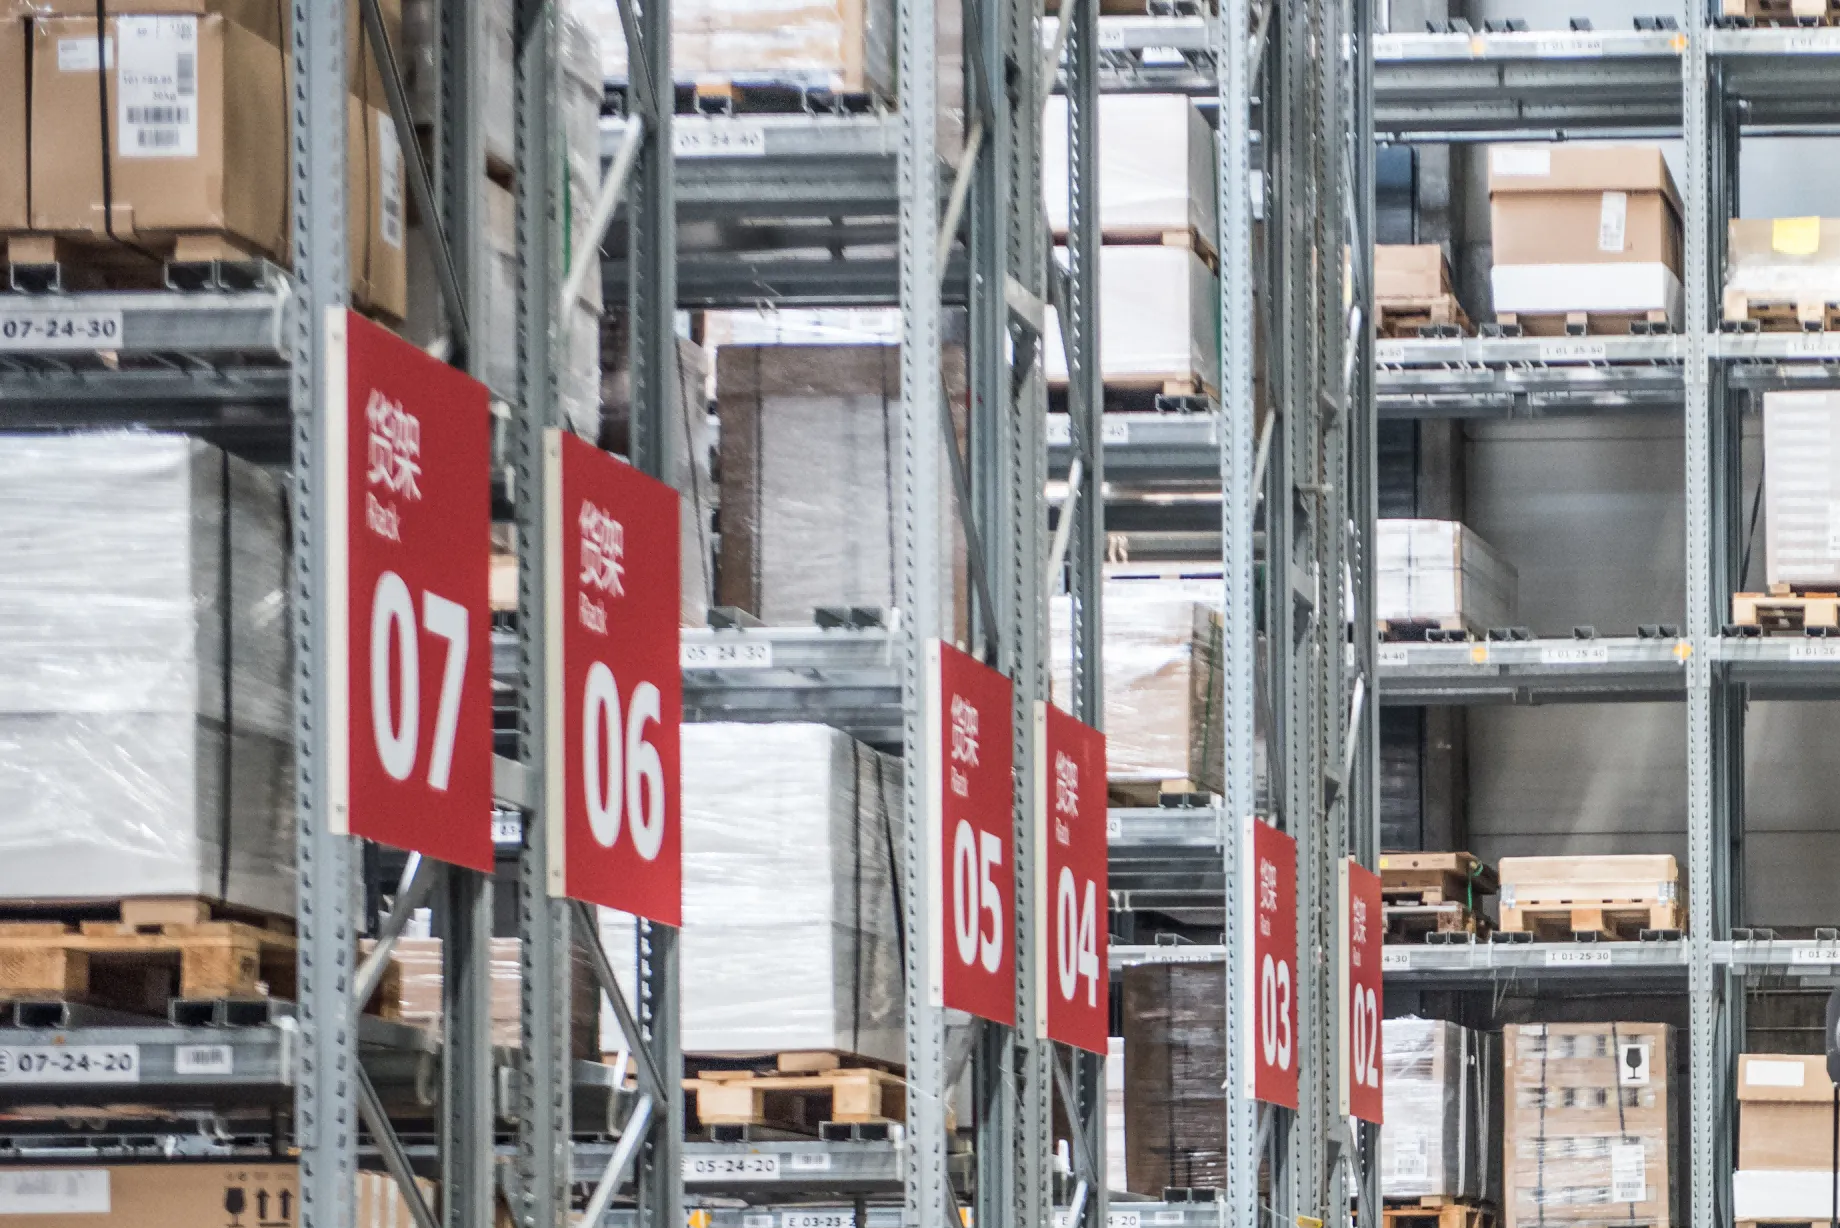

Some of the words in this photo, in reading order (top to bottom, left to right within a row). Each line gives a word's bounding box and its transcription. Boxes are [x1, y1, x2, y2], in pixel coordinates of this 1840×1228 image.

[3, 319, 117, 338] 07-24-30
[366, 387, 421, 500] 货架
[366, 492, 402, 542] Rack
[579, 498, 625, 597] 货架
[579, 591, 608, 636] Rack
[370, 569, 469, 791] 07
[583, 660, 665, 861] 06
[951, 692, 979, 767] 货架
[951, 765, 970, 798] Rack
[1055, 749, 1079, 817] 货架
[954, 818, 1004, 974] 05
[1260, 855, 1277, 912] 货架
[1057, 865, 1100, 1008] 04
[1353, 894, 1366, 944] 货架
[1562, 952, 1609, 961] 01-25-30
[1262, 953, 1292, 1071] 03
[1353, 982, 1379, 1089] 02
[18, 1053, 133, 1073] 07-24-20
[696, 1159, 775, 1173] 05-24-20
[803, 1216, 856, 1228] 03-23-2
